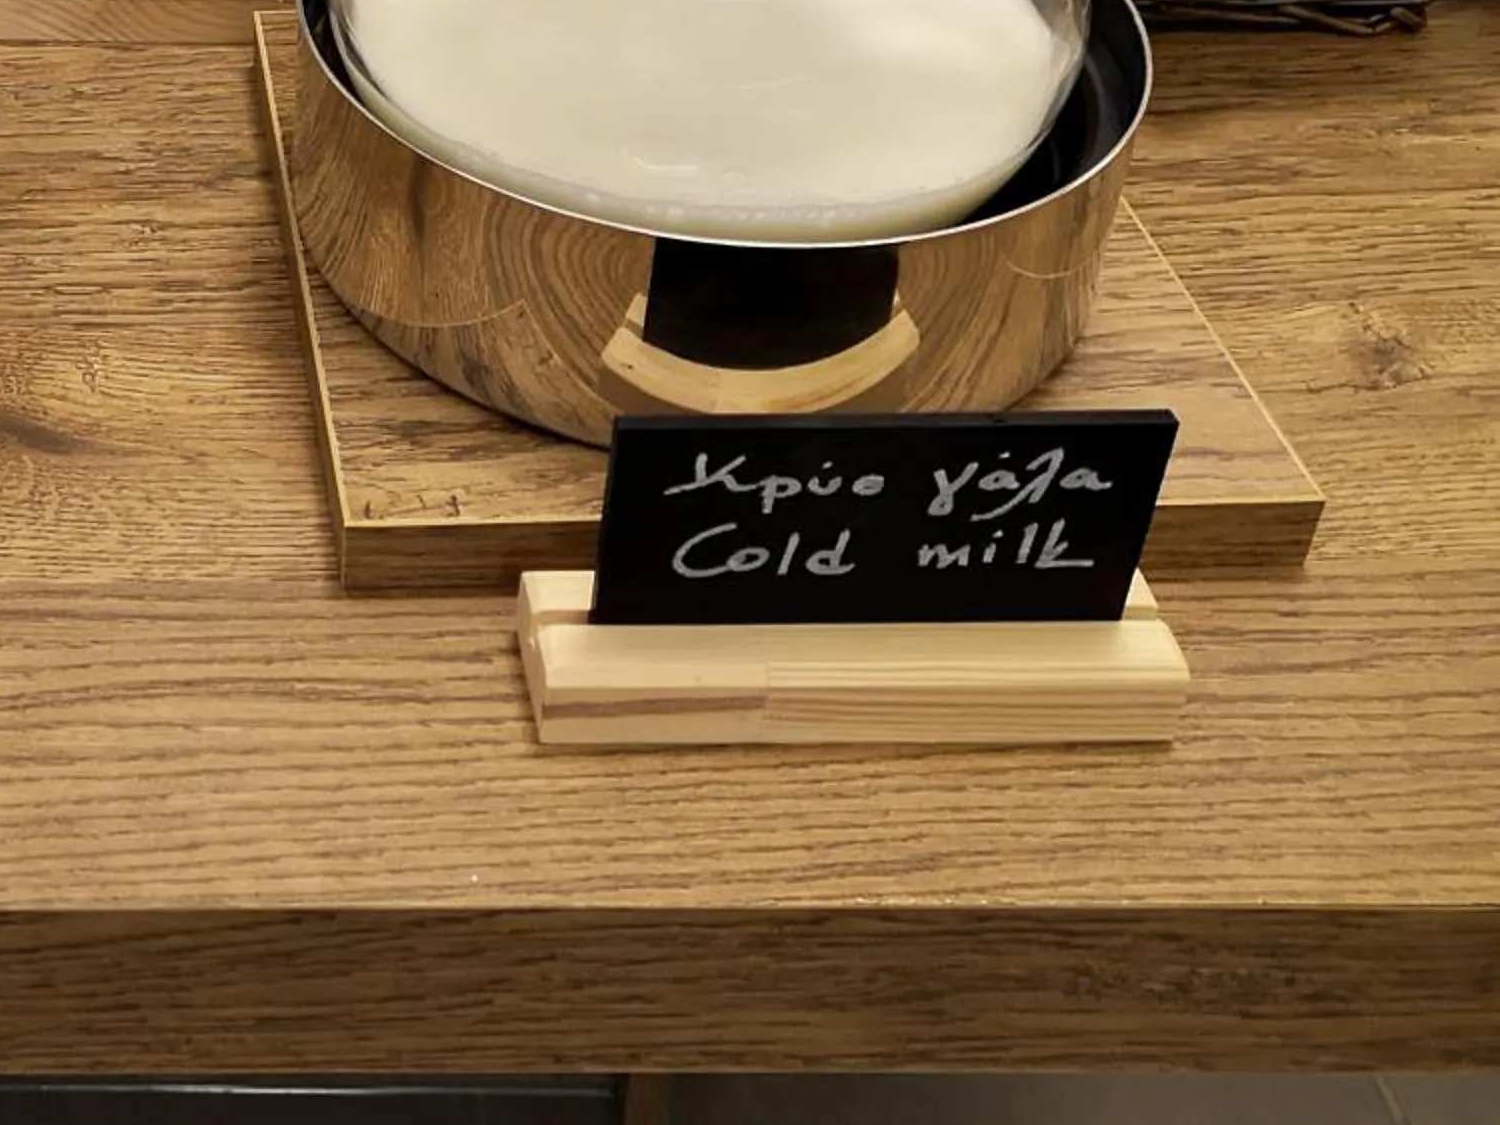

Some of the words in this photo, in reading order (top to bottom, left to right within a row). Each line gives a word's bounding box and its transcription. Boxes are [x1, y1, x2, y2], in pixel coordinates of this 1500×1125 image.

[927, 447, 1112, 521] γάλα
[672, 523, 855, 577] Cold
[918, 518, 1094, 569] milk
